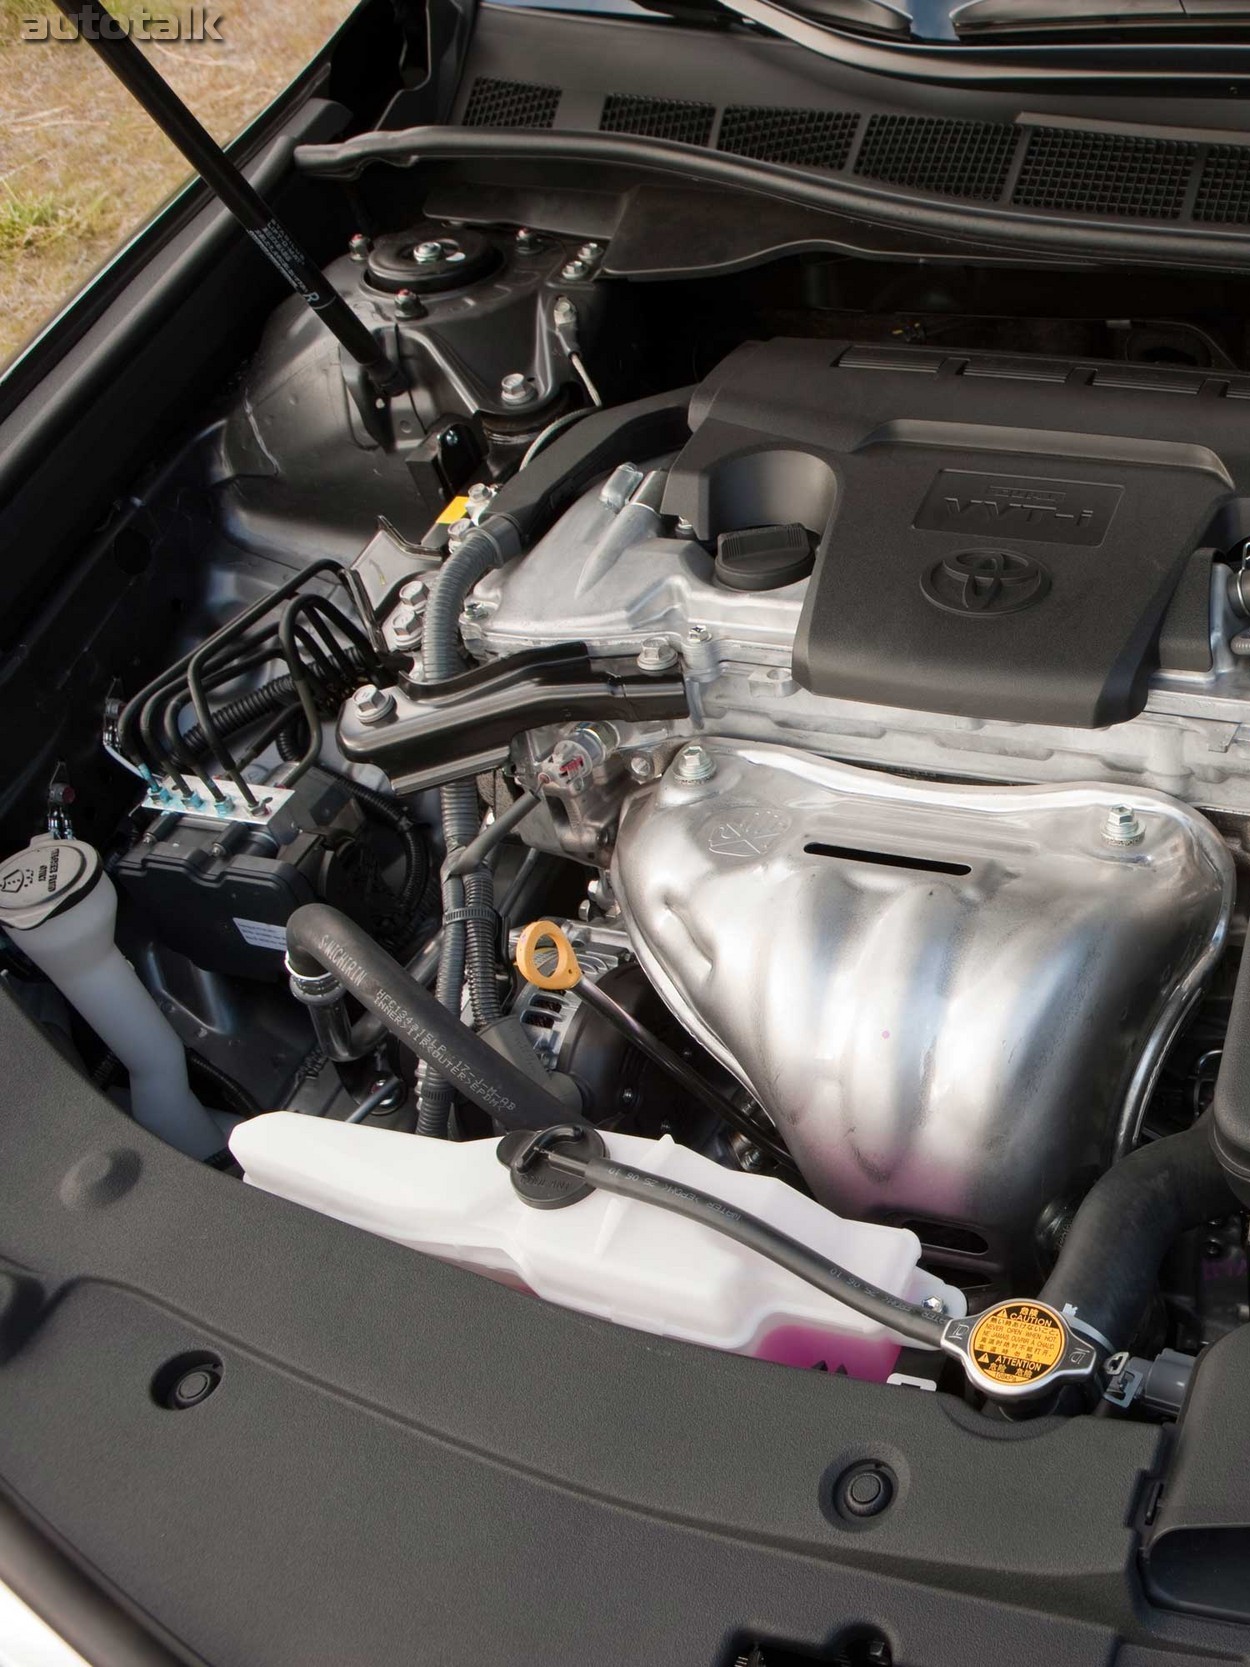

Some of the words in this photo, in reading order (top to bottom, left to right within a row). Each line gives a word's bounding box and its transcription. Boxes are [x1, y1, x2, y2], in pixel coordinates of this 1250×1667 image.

[608, 1168, 621, 1177] 10
[830, 1268, 843, 1278] 10
[1010, 1313, 1053, 1327] CAUTION
[986, 1323, 1004, 1332] NEVER
[1007, 1327, 1022, 1335] OPEN
[1026, 1330, 1041, 1339] WHEN
[1011, 1336, 1030, 1344] OUVRIR
[995, 1356, 1042, 1371] ATTENTION
